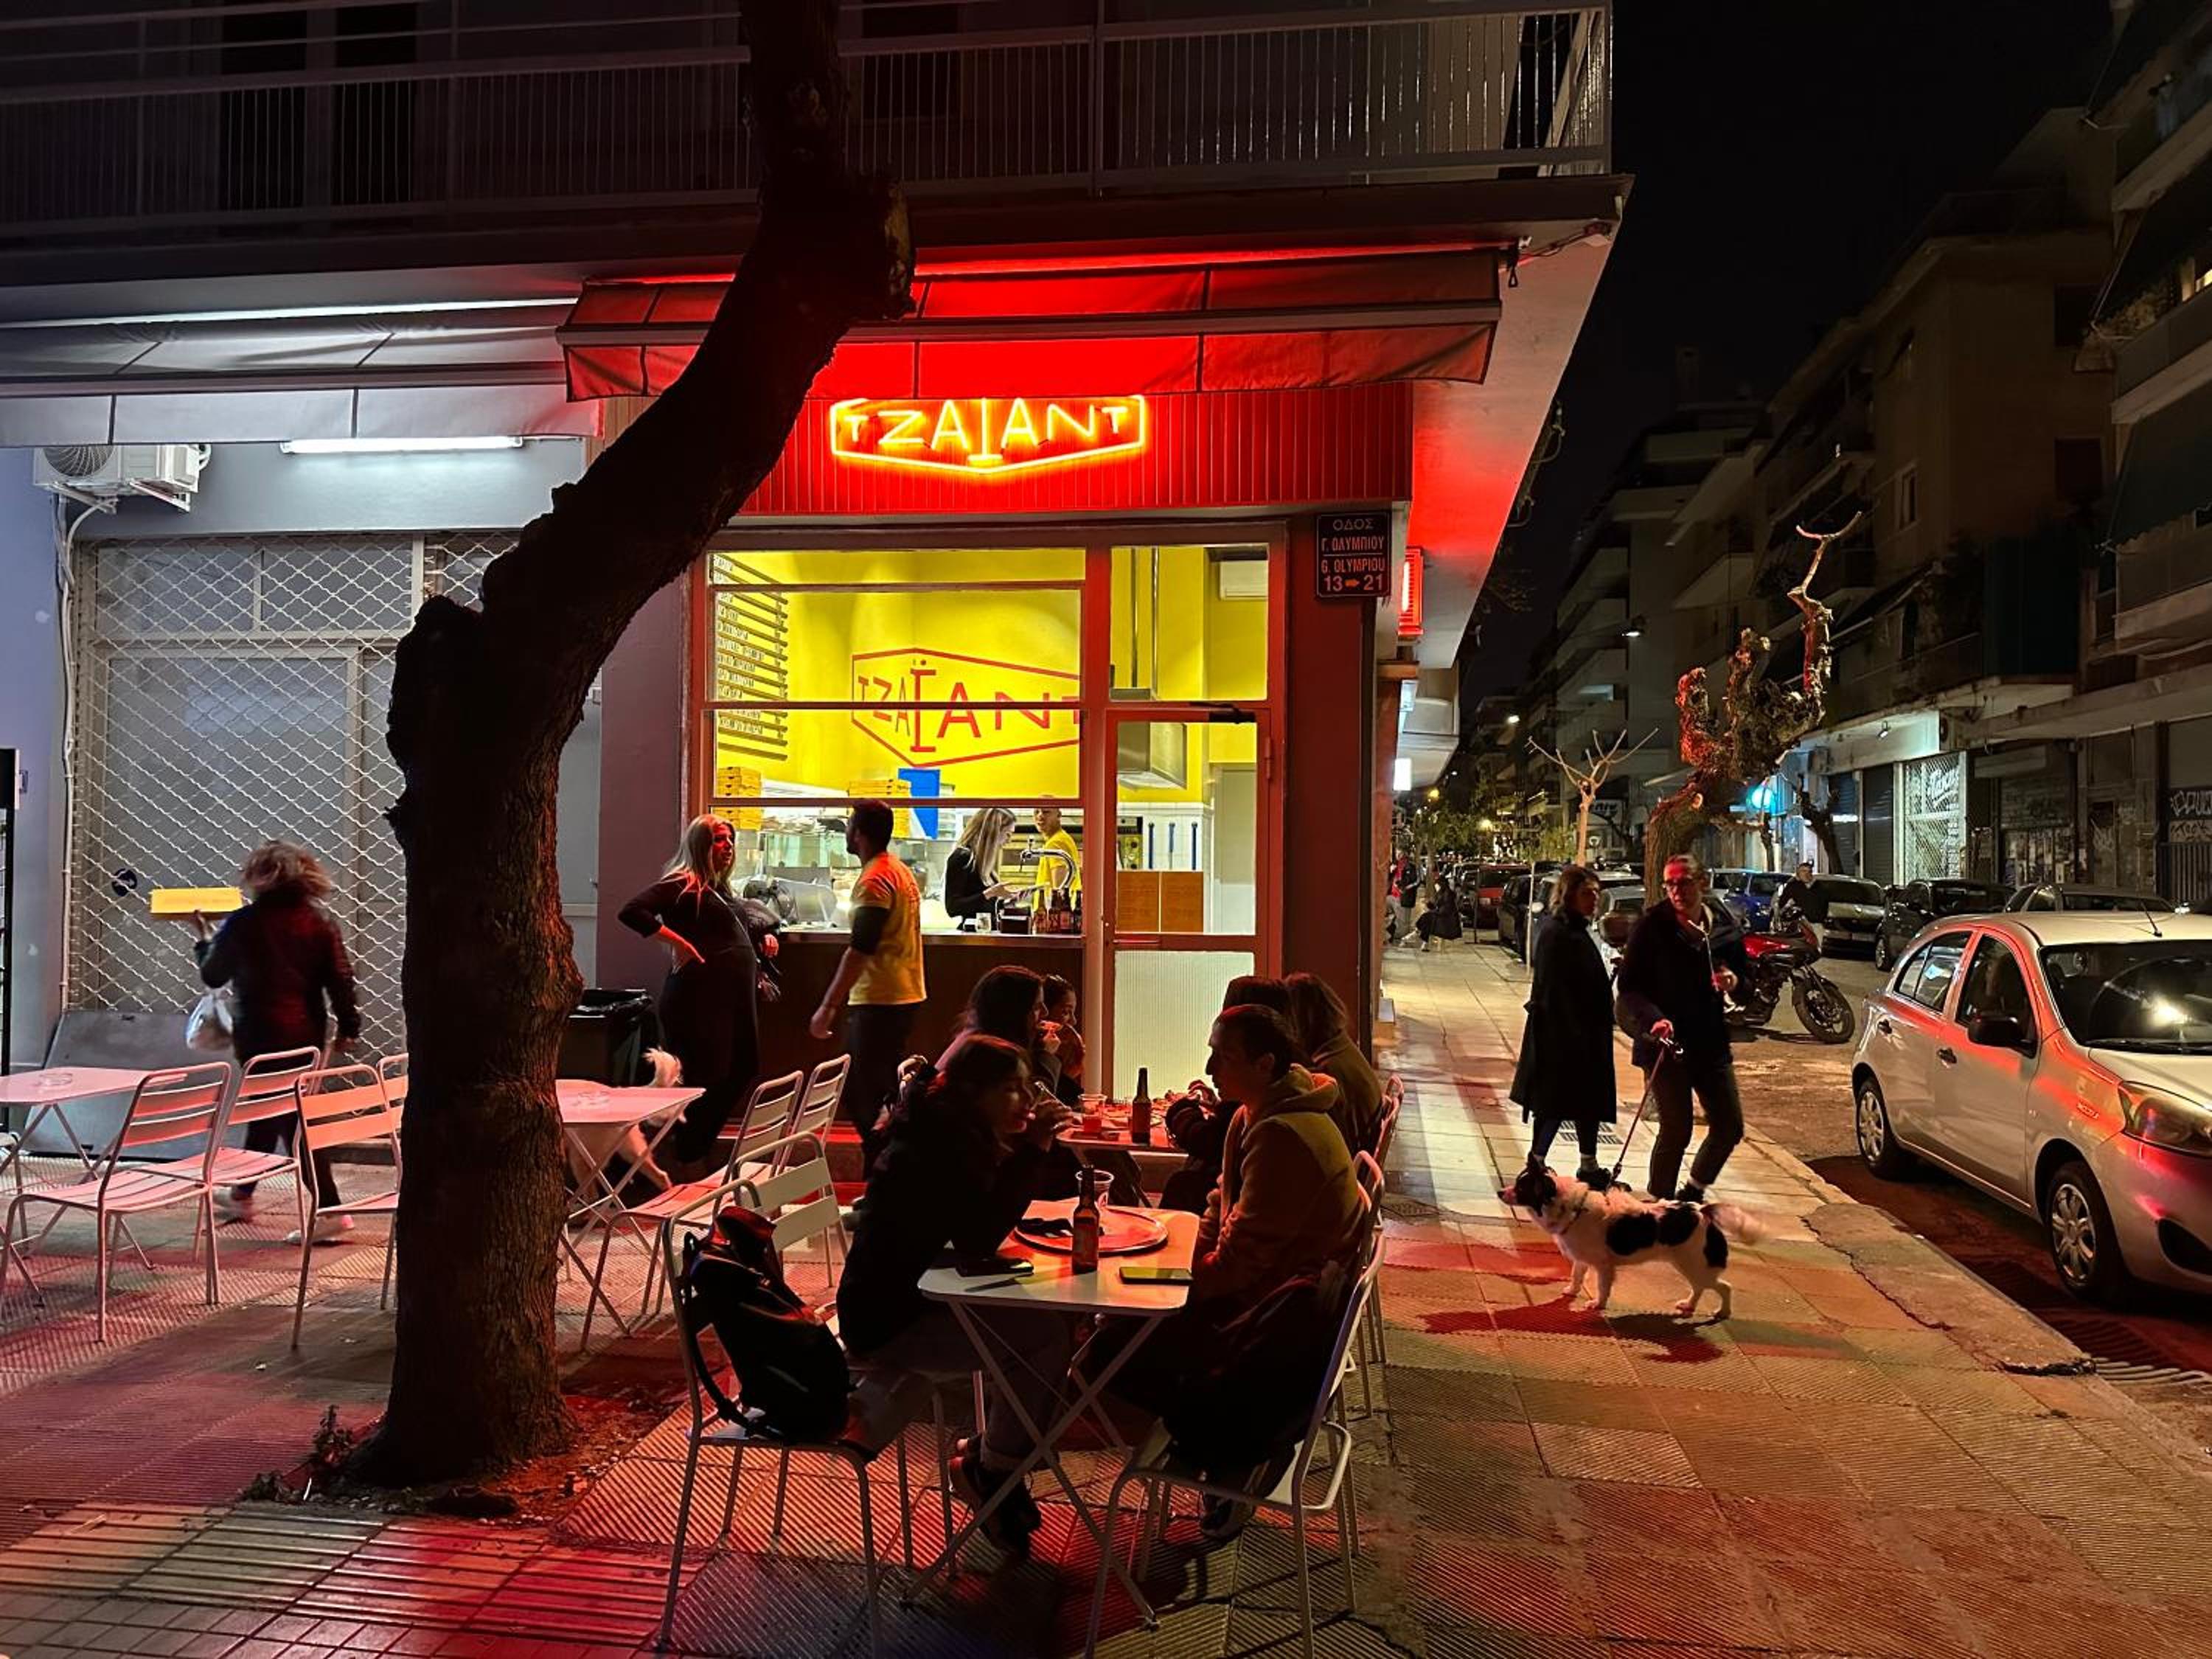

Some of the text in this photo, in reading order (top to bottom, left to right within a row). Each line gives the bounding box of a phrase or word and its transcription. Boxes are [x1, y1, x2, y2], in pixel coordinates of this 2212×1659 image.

[1332, 518, 1374, 531] ΟΔΟΣ
[1332, 535, 1385, 552] ΟΛΥΜΠΙΟΥ
[1321, 557, 1385, 574] G. OLYMPIOU
[1324, 574, 1383, 592] 13 21
